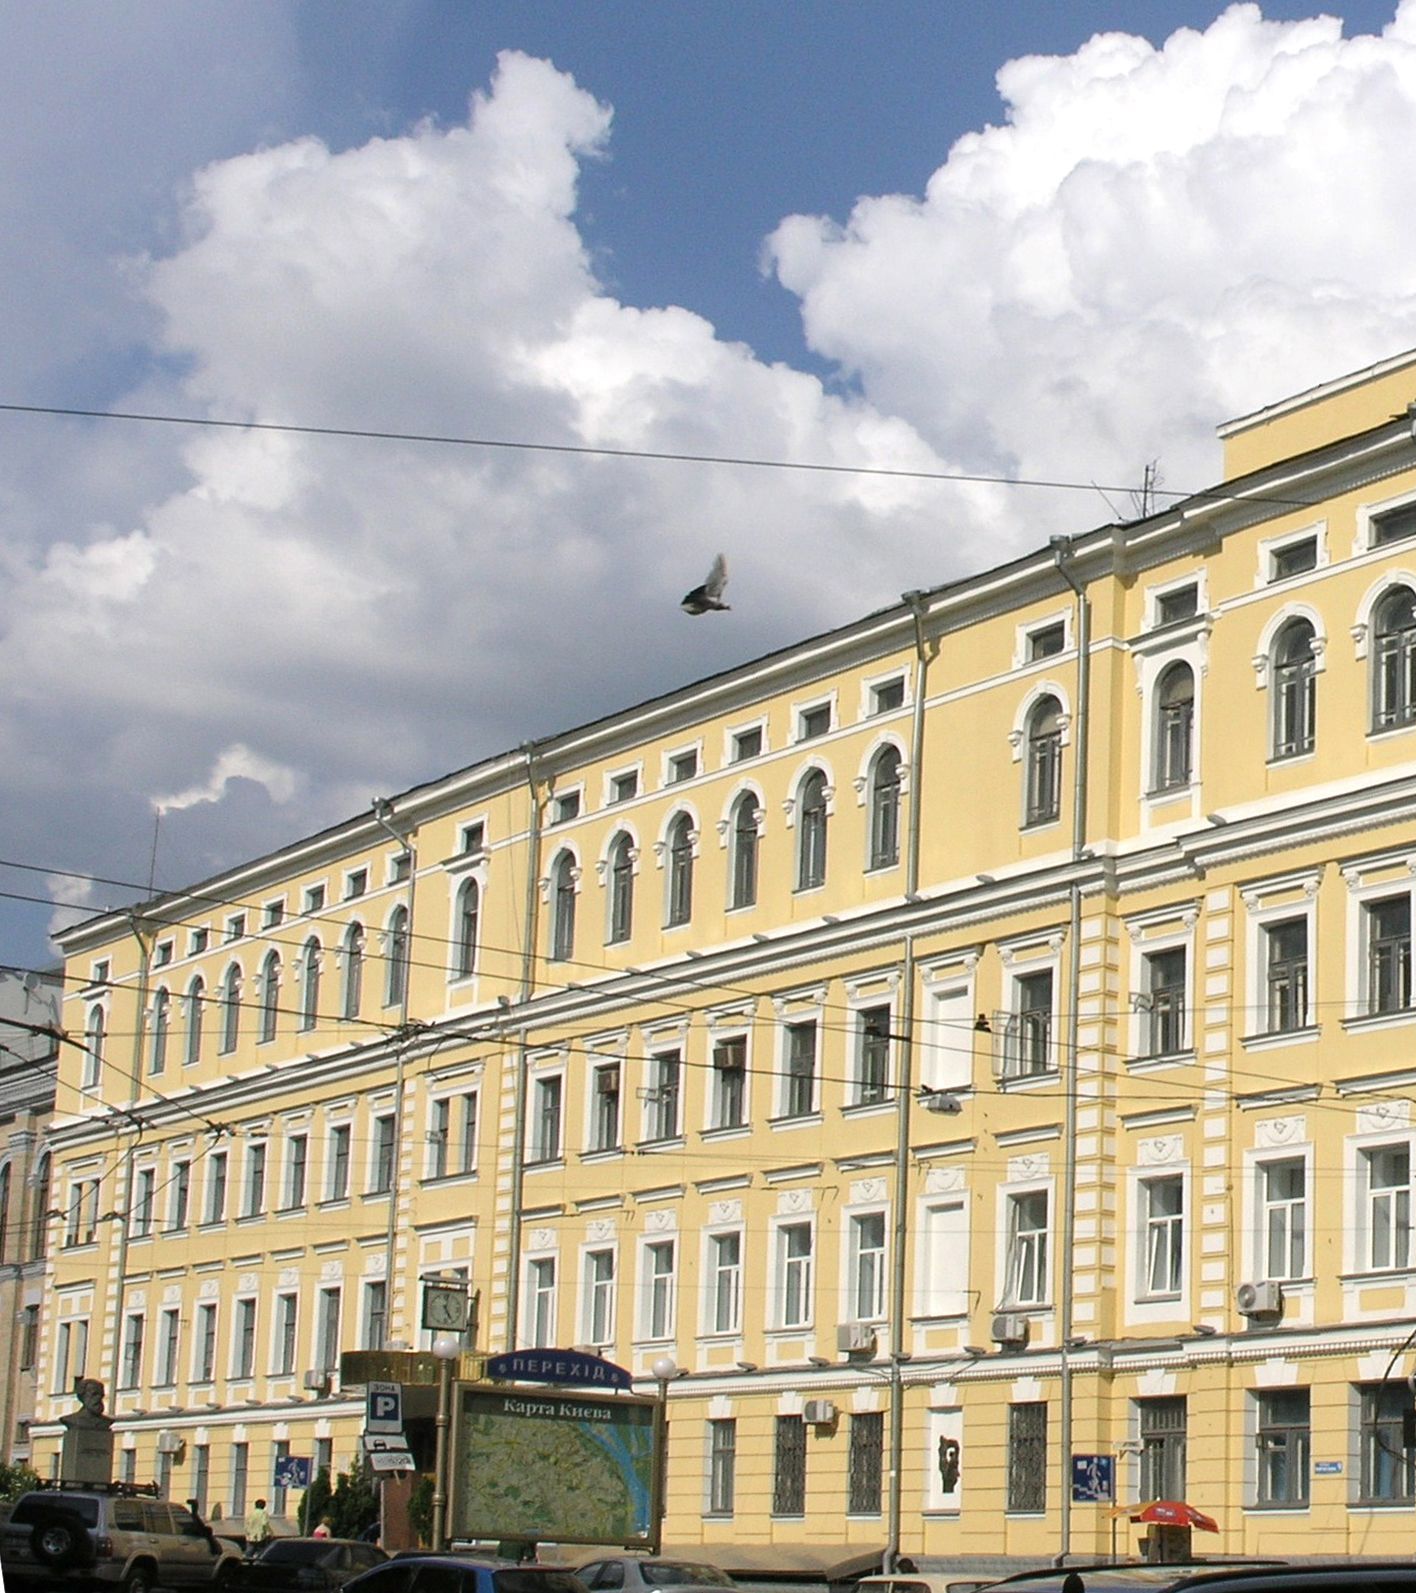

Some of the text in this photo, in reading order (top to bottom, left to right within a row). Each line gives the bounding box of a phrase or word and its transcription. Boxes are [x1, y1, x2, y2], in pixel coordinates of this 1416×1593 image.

[512, 1358, 605, 1381] ПЕРЕХІД
[376, 1396, 396, 1417] P
[503, 1399, 612, 1420] Карта Києва
